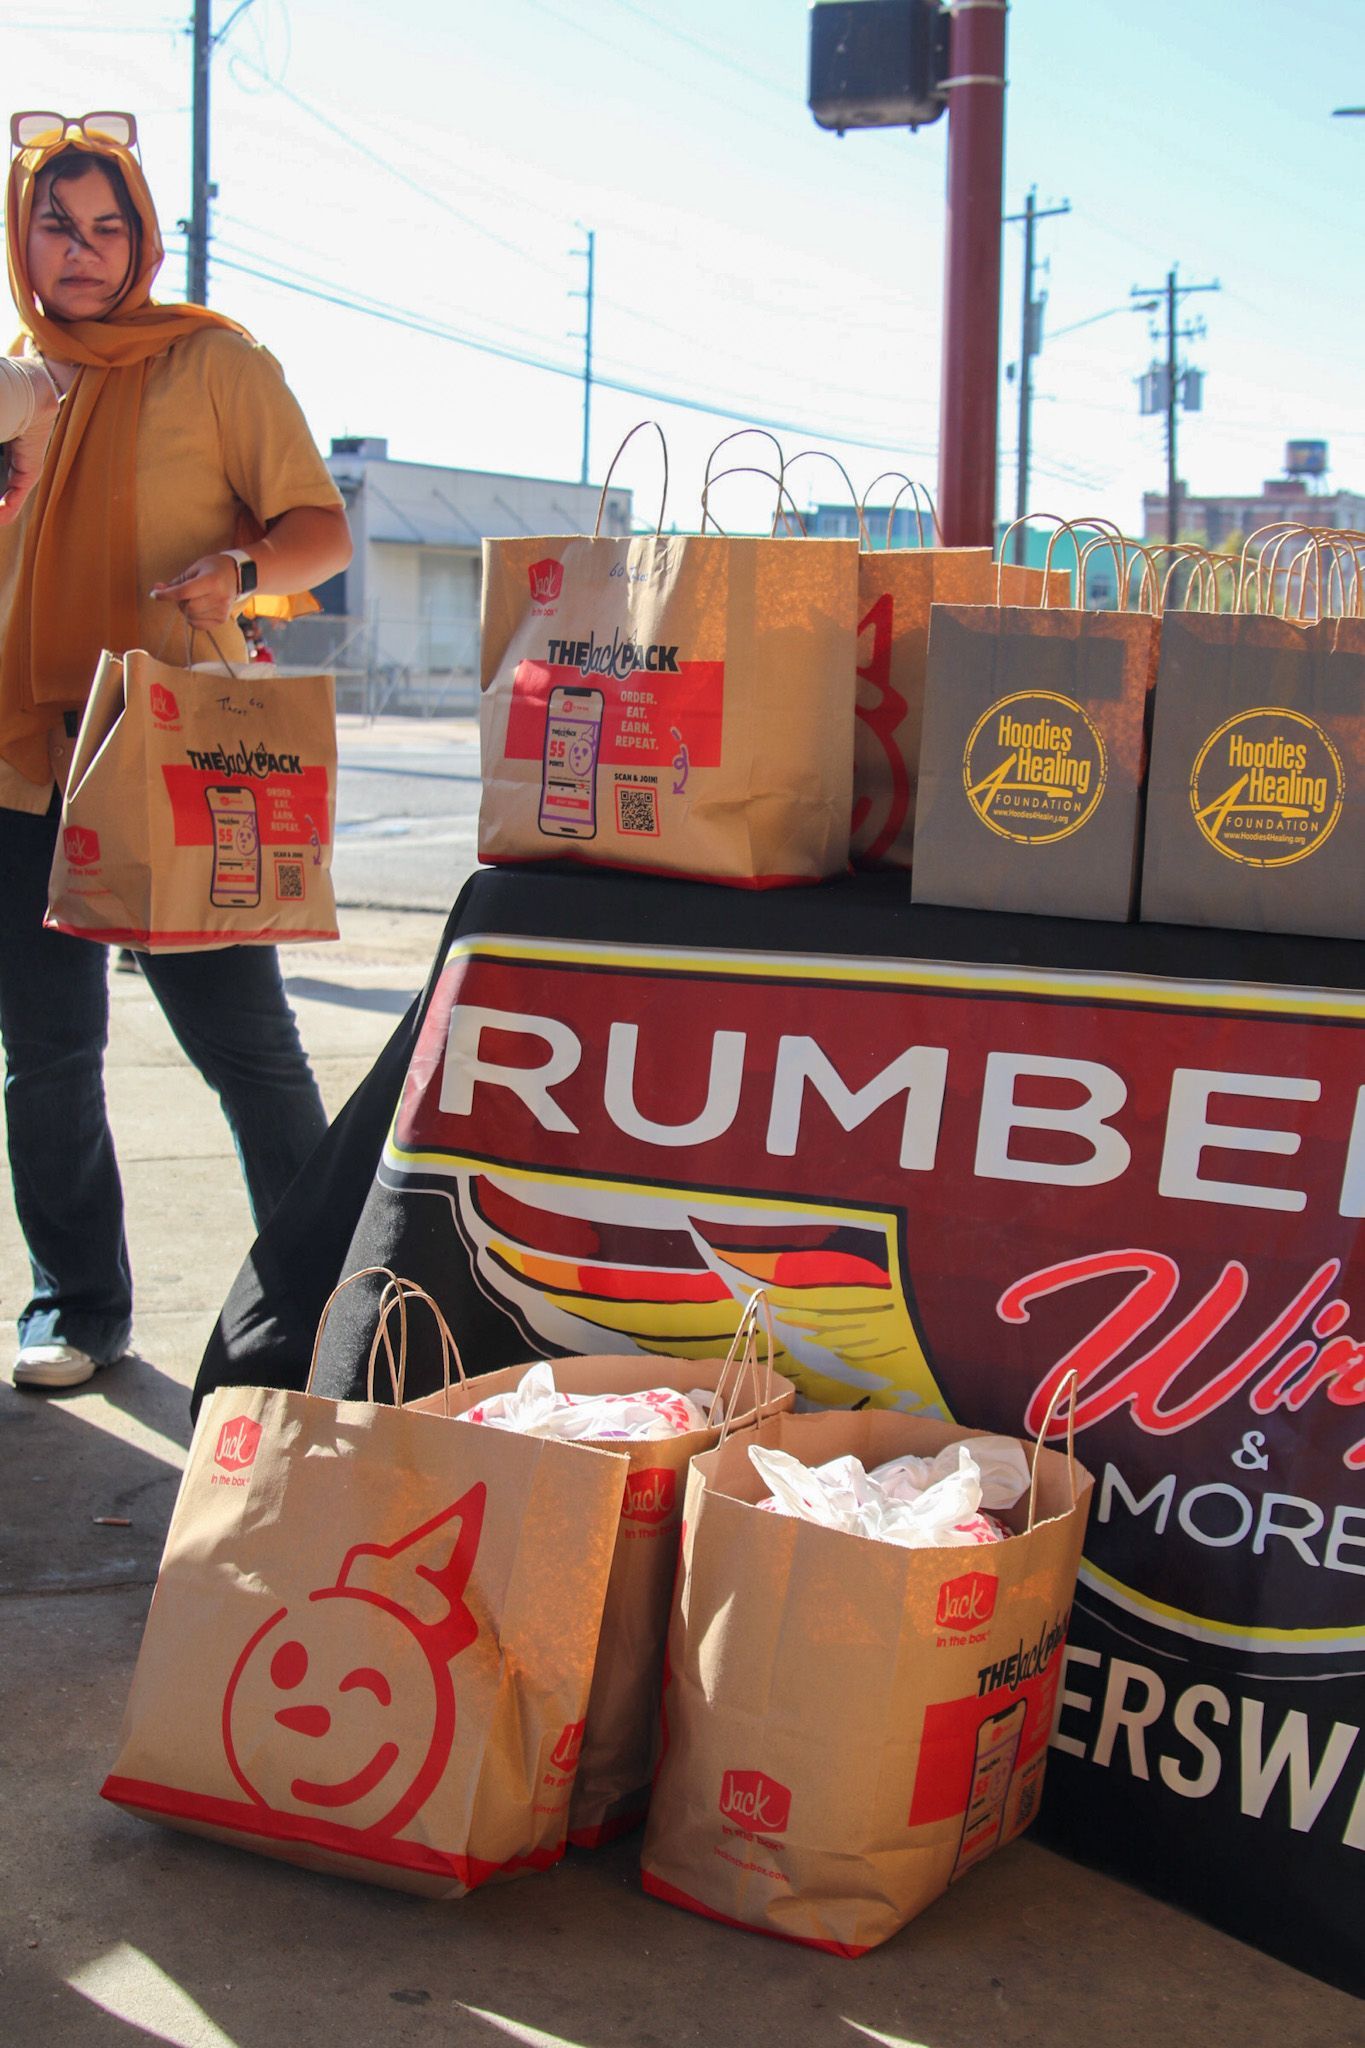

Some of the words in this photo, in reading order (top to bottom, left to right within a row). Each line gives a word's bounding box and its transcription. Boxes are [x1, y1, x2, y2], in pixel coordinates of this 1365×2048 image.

[532, 564, 561, 599] Jack
[620, 690, 657, 705] ORDER.
[626, 706, 647, 719] EAT.
[615, 735, 659, 750] REPEAT.
[621, 721, 653, 735] EARN.
[997, 715, 1072, 751] Hoodies
[1229, 735, 1307, 769] Hoodies
[614, 773, 632, 781] SCAN
[633, 774, 638, 782] &
[640, 775, 658, 784] JOIN!
[1017, 747, 1091, 794] Healing
[995, 794, 1082, 812] FOUNDATION
[1249, 767, 1327, 813] Healing
[1223, 831, 1306, 845] www.Hoodies4Healing.org
[1226, 816, 1319, 832] FOUNDATION
[439, 1005, 1365, 1218] RUMBE
[996, 1249, 1365, 1470] Win
[216, 1422, 255, 1463] Jack
[1231, 1430, 1268, 1471] &
[623, 1474, 673, 1515] Jack
[938, 1579, 990, 1623] Jack
[937, 1637, 947, 1648] in
[950, 1635, 967, 1647] the
[1048, 1644, 1365, 1851] ERSW
[722, 1775, 786, 1827] Jack
